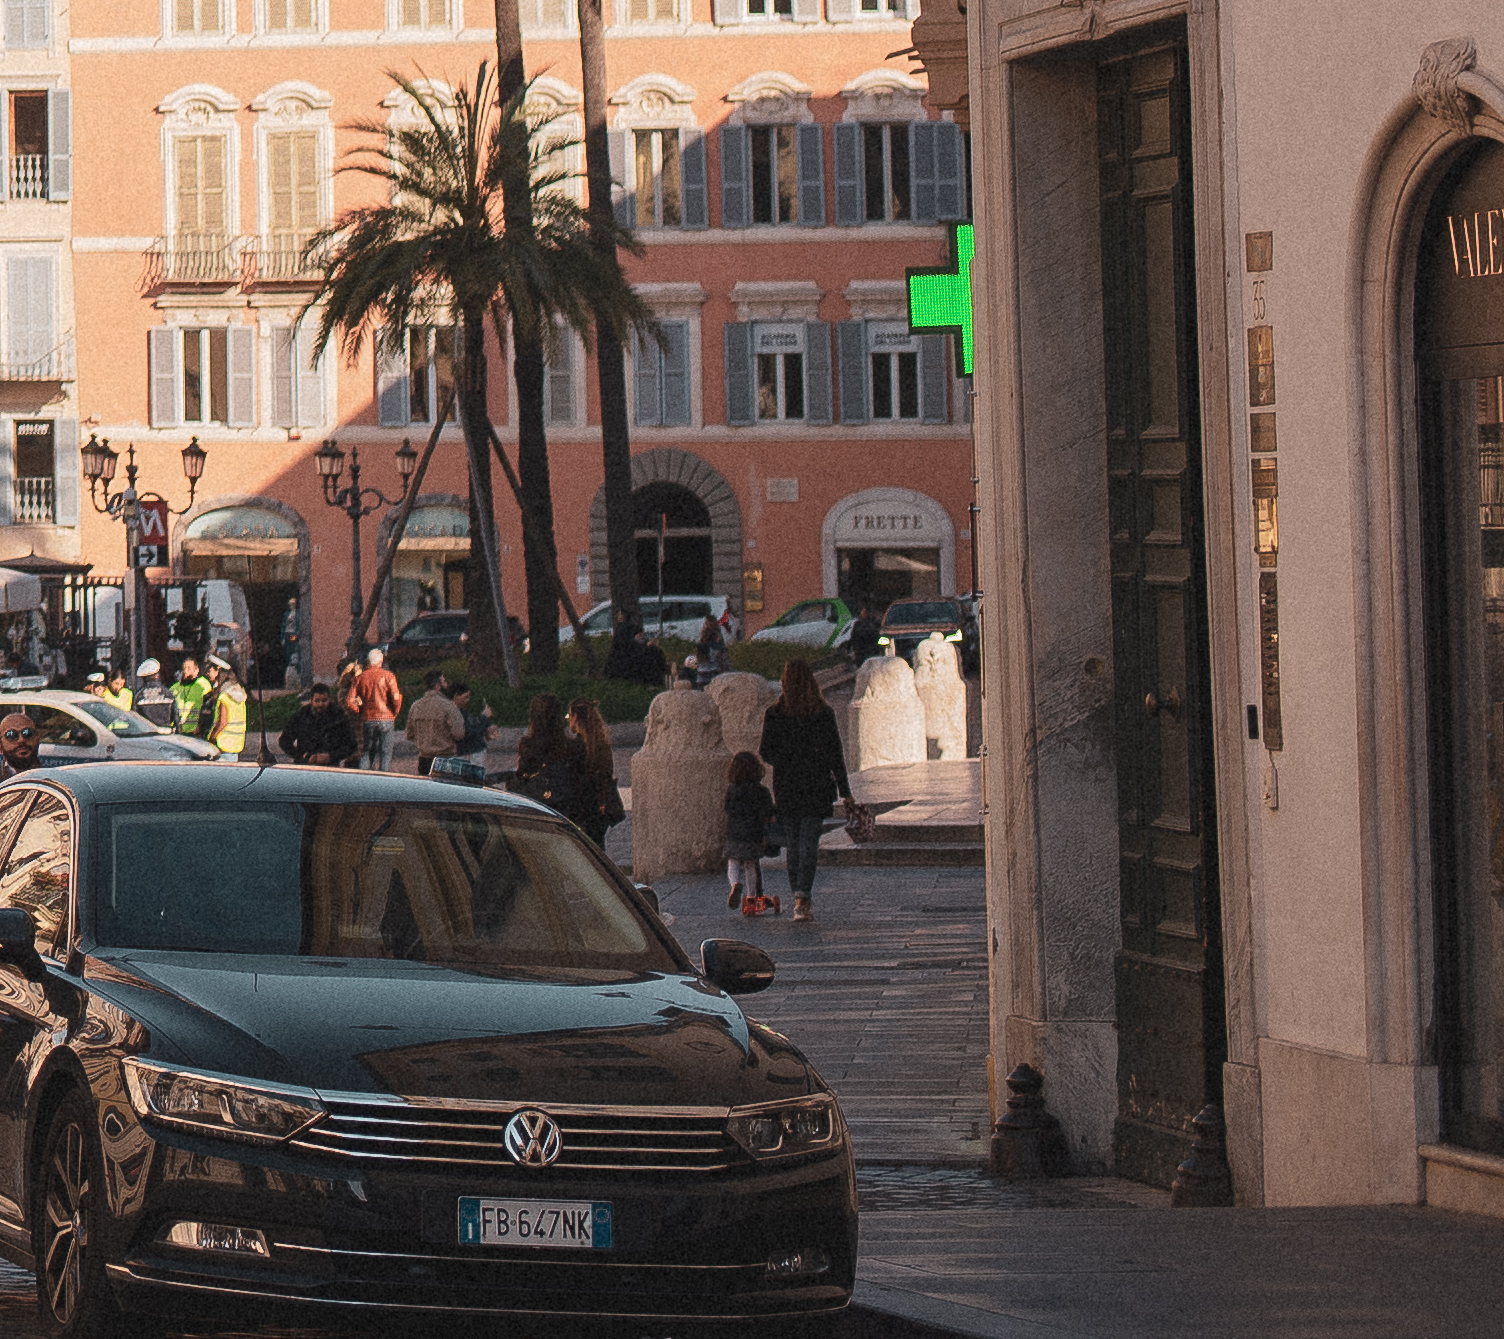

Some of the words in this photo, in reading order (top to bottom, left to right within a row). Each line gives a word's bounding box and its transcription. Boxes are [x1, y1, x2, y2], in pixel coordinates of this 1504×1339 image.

[1446, 208, 1504, 279] VALE
[1252, 280, 1266, 320] 35
[853, 514, 924, 530] FRETTE
[481, 1206, 510, 1237] FB
[517, 1208, 591, 1240] 647NK
